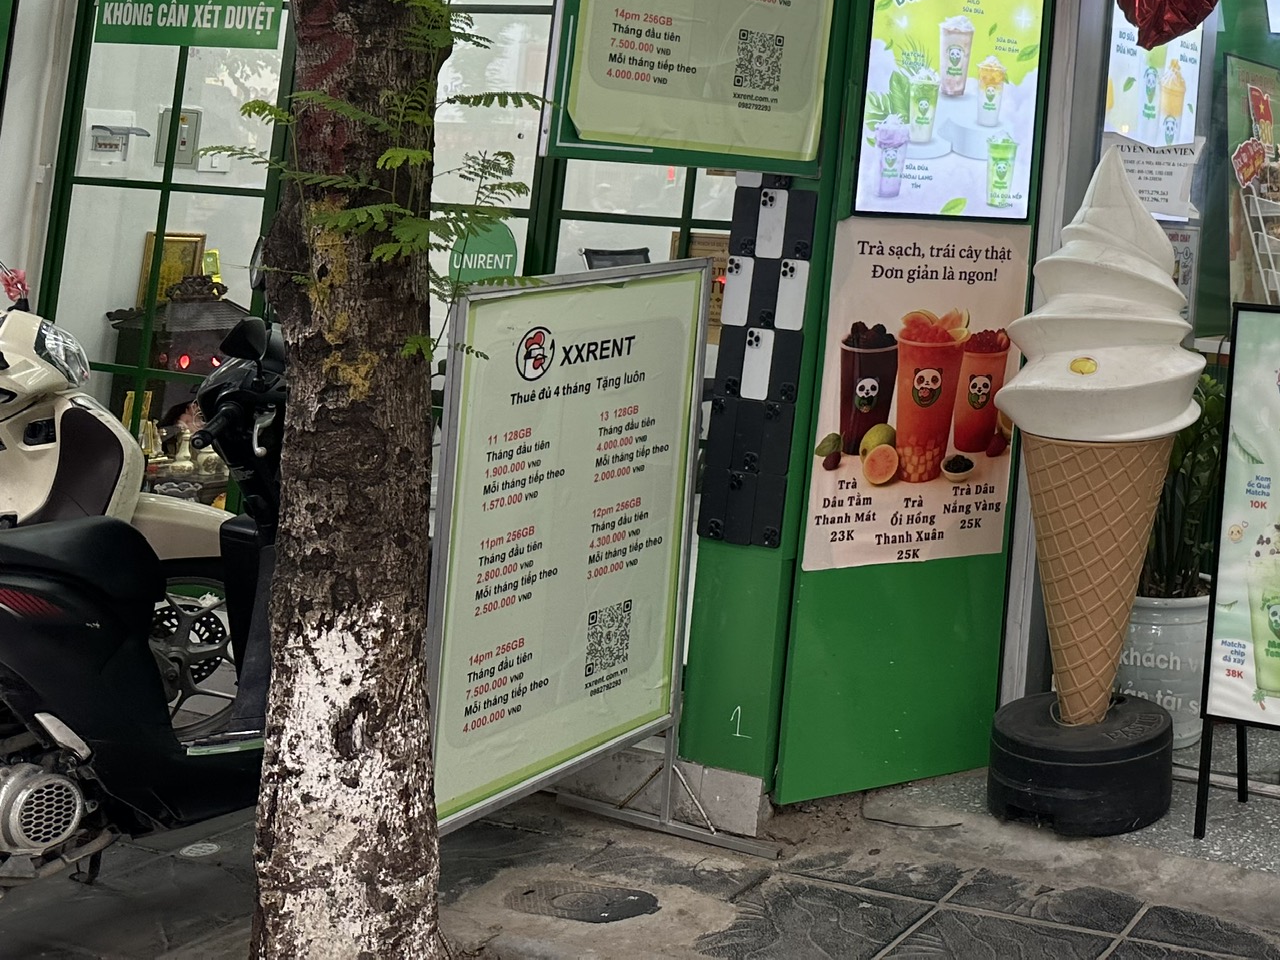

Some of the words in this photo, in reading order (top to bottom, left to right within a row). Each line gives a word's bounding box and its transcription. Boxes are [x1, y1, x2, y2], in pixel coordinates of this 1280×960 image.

[192, 0, 222, 29] XÉT
[224, 1, 276, 36] DUYỆT
[857, 240, 885, 256] Trà
[888, 242, 925, 259] sạch,
[929, 243, 956, 259] trái
[959, 245, 983, 263] cây
[984, 246, 1013, 264] thật
[452, 252, 513, 271] UNIRENT
[871, 264, 904, 279] Đơn
[906, 264, 939, 283] giản
[942, 266, 955, 281] là
[958, 268, 998, 285] ngon!
[560, 335, 636, 367] XXRENT
[837, 477, 858, 490] Trà
[952, 484, 972, 497] Trà
[974, 484, 996, 495] Dâu
[822, 496, 844, 509] Dâu
[903, 494, 924, 509] Trà
[943, 501, 972, 515] Nắng
[974, 499, 1002, 512] Vàng
[1250, 499, 1268, 510] 10K
[814, 514, 851, 526] Thanh
[854, 511, 877, 523] Mát
[959, 518, 982, 529] 25K
[830, 529, 855, 542] 23K
[875, 532, 912, 545] Thanh
[915, 528, 945, 542] Xuân
[896, 548, 920, 561] 25K
[1225, 668, 1244, 680] 38K
